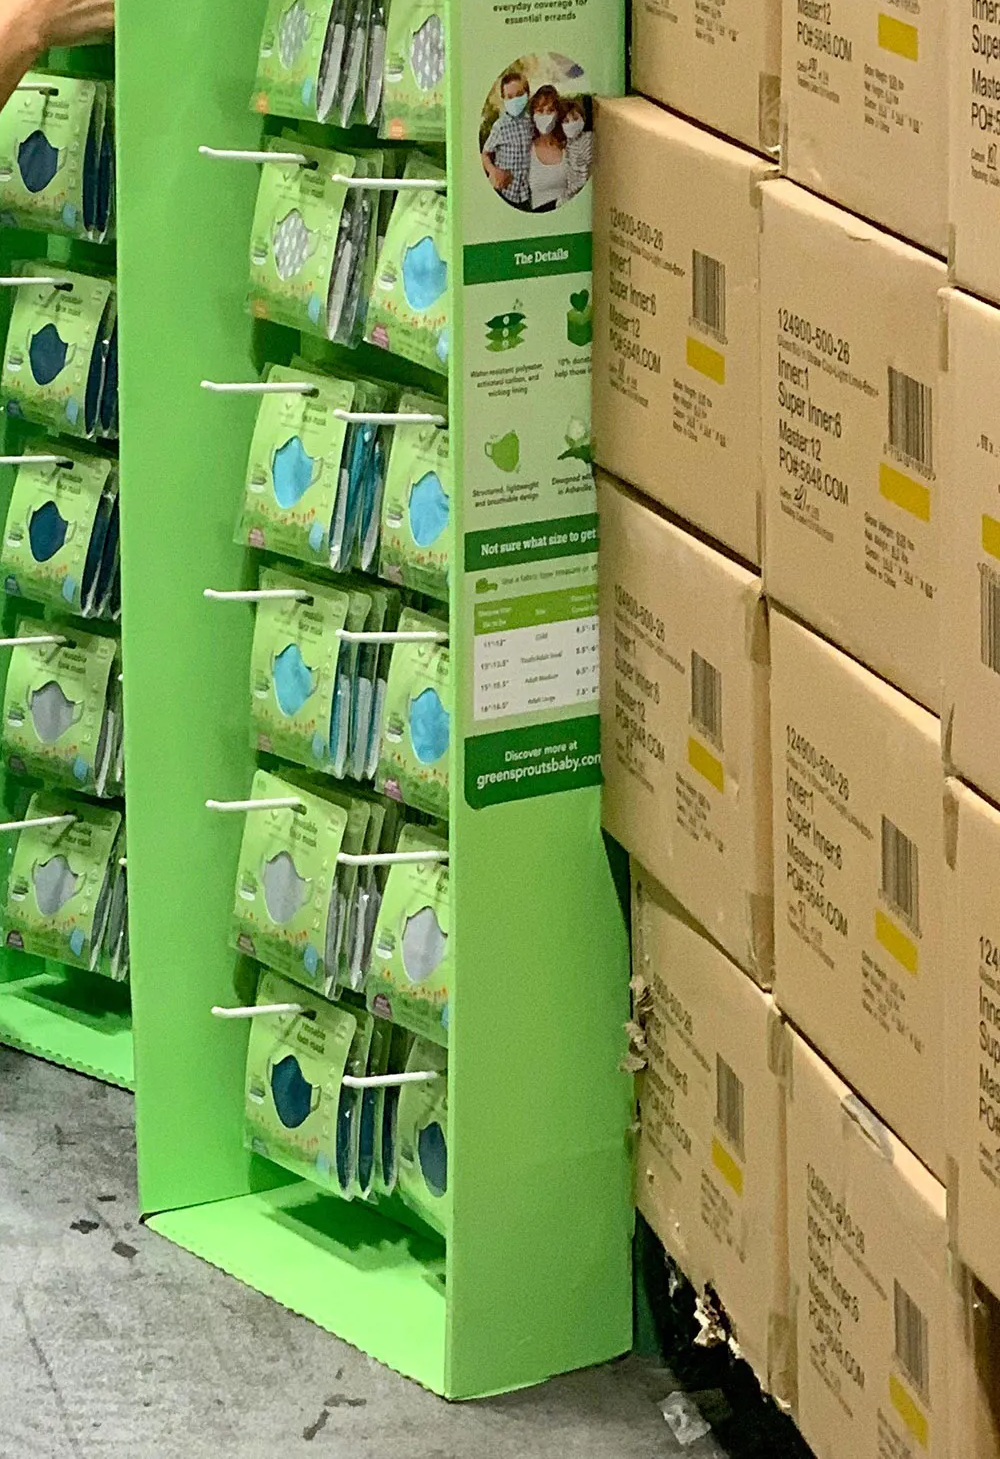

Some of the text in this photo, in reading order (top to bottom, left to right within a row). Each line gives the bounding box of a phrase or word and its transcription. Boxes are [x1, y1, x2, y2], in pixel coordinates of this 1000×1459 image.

[493, 1, 532, 14] everyday
[504, 10, 577, 25] essential errands
[514, 247, 569, 266] The Details
[777, 307, 851, 365] 124900-500-26
[777, 380, 843, 439] Super Inner:6
[480, 528, 598, 556] Not sure what size to get
[504, 740, 579, 763] Discover more at
